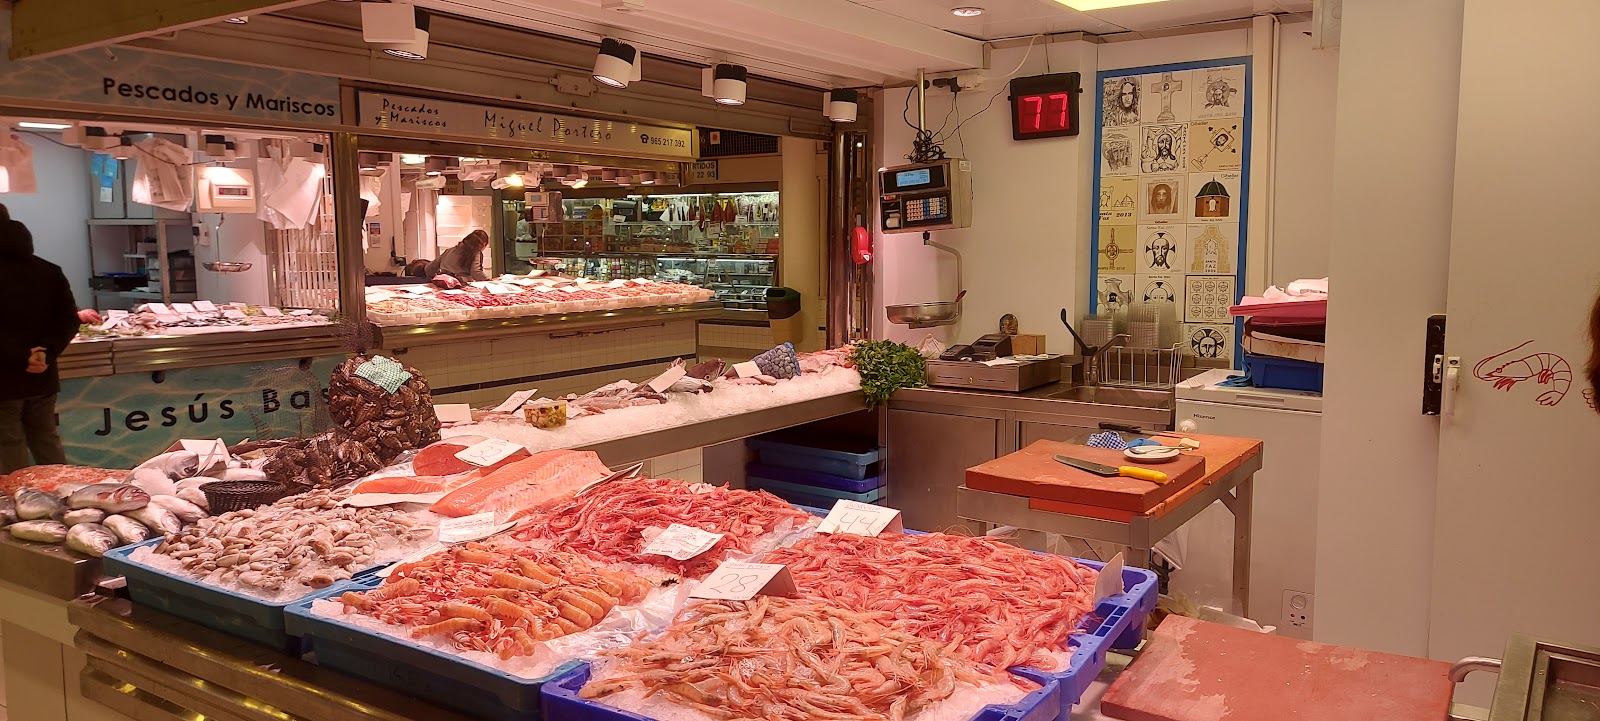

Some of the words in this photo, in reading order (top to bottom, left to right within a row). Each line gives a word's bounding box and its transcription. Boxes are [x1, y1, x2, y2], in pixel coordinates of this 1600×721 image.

[102, 77, 219, 105] Pescados
[226, 94, 239, 110] y
[246, 92, 335, 116] Mariscos
[382, 98, 439, 115] Pescados
[390, 111, 447, 128] Mariscos
[1023, 93, 1068, 130] 77
[484, 110, 542, 137] Miguel
[553, 117, 612, 140] Portero
[662, 138, 674, 146] 217
[674, 139, 685, 148] 392
[94, 392, 235, 437] Jesús
[840, 512, 879, 531] 44
[709, 573, 759, 594] 28
